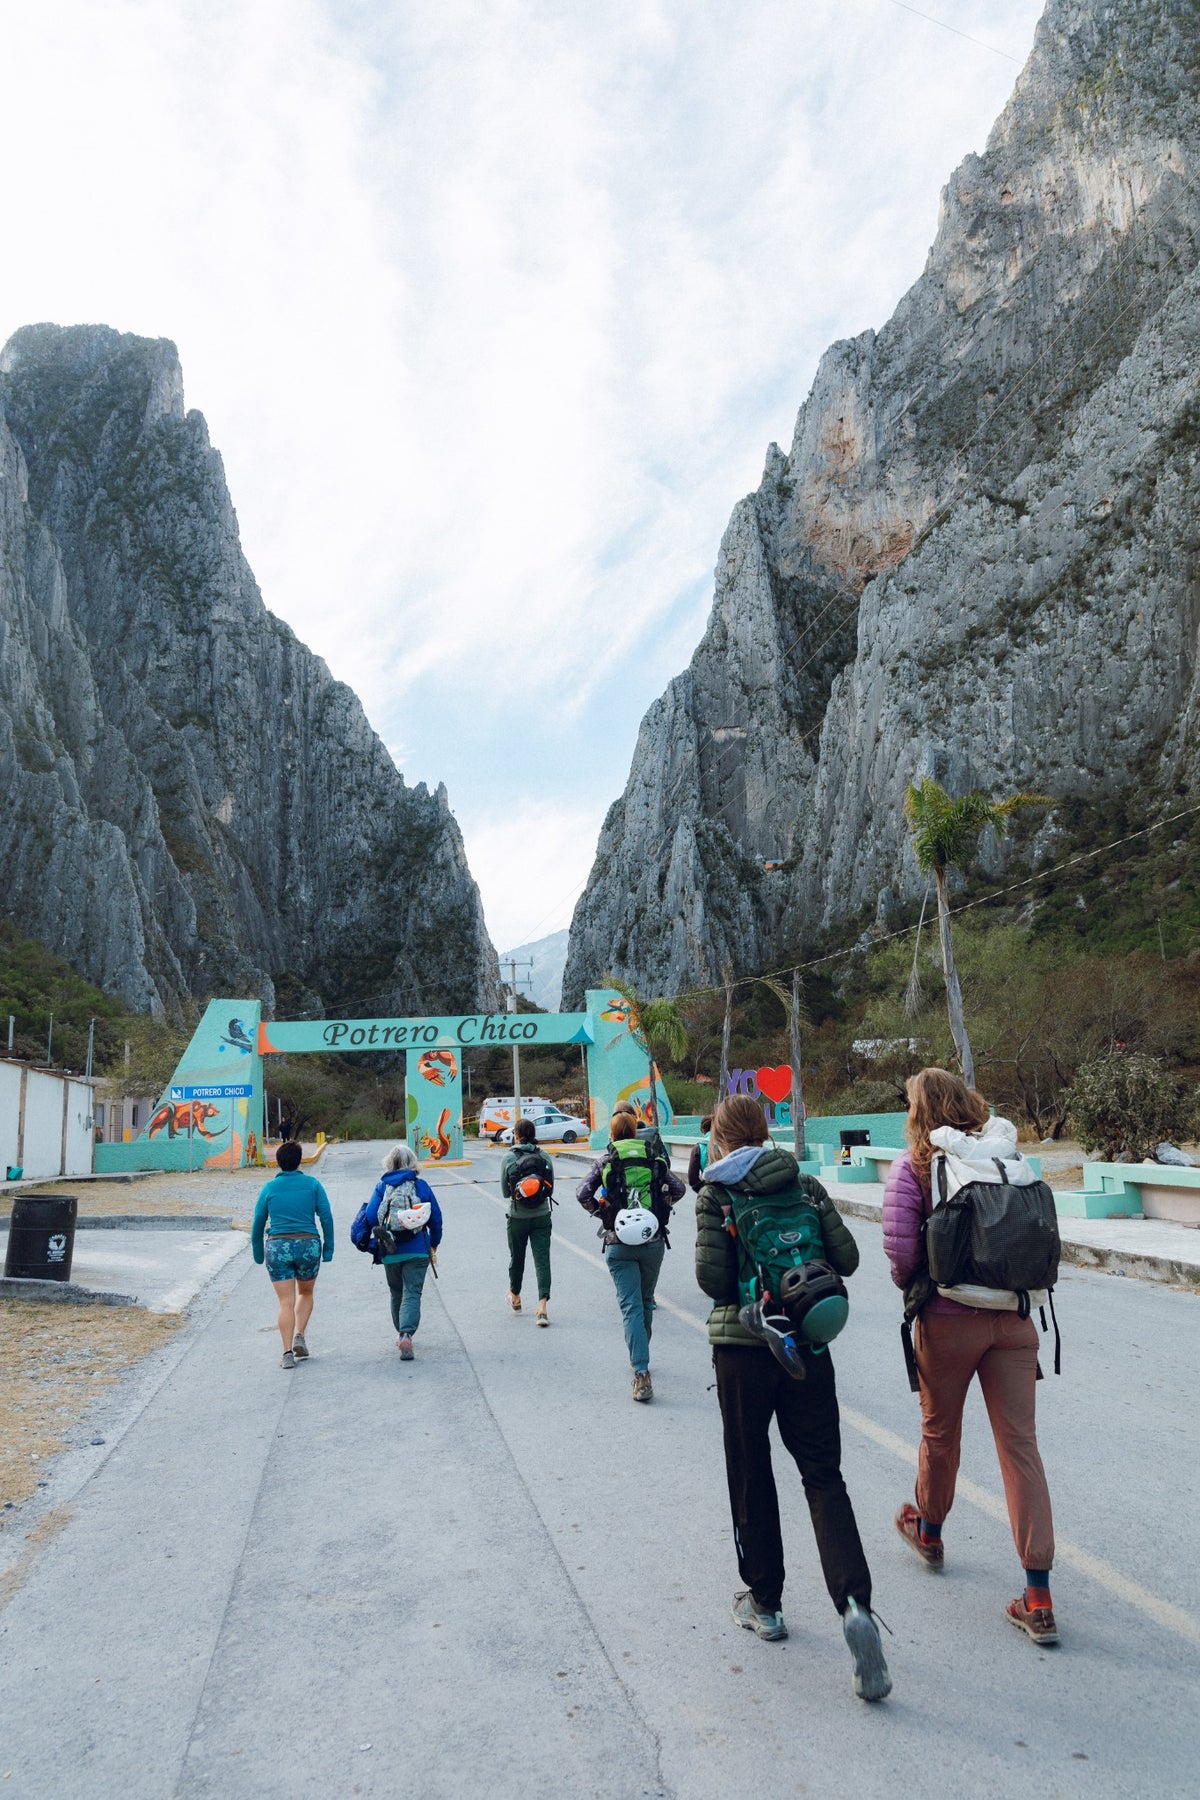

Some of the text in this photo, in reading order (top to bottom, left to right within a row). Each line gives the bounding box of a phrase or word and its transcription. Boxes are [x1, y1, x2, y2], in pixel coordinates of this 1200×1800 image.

[323, 1015, 538, 1046] Potrero Chico
[192, 1087, 244, 1097] POTRERO CHICO
[726, 1069, 761, 1100] YO
